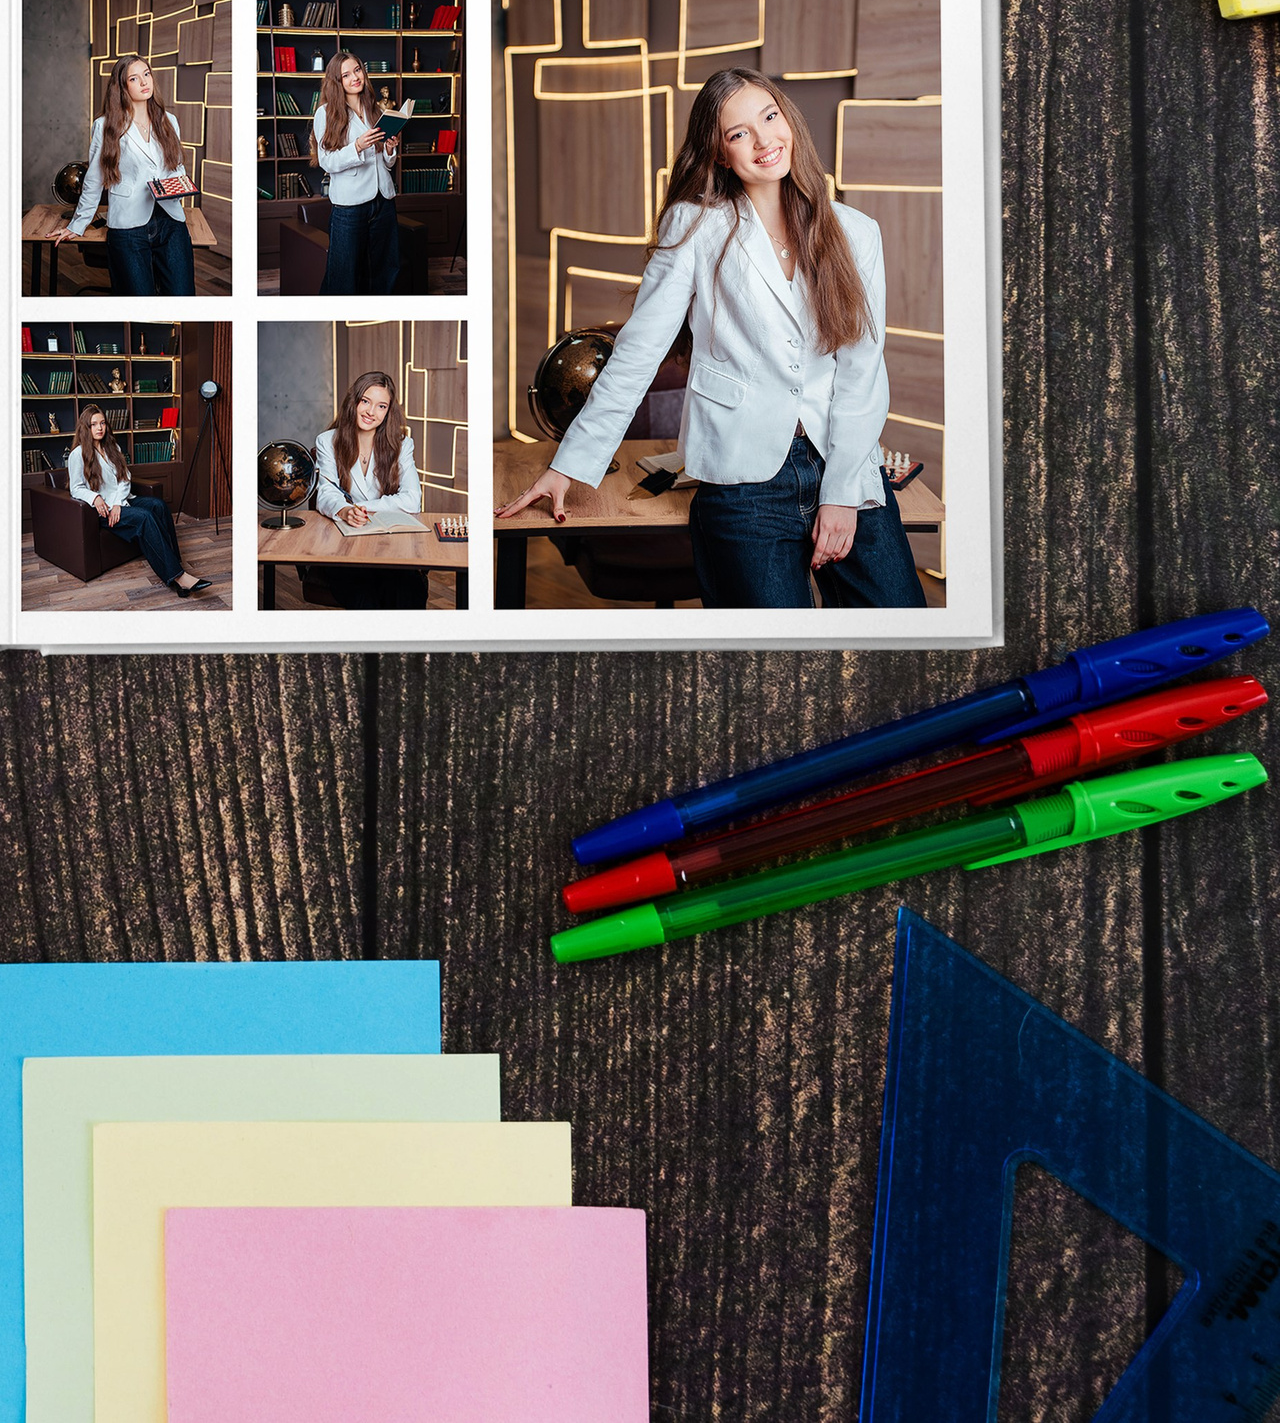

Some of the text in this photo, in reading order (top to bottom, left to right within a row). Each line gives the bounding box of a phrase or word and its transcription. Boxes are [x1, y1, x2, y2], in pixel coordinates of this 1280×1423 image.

[1200, 1259, 1251, 1328] порядке
[1226, 1234, 1280, 1321] тамм.
[1252, 1351, 1268, 1366] 3
[1223, 1392, 1237, 1405] 4
